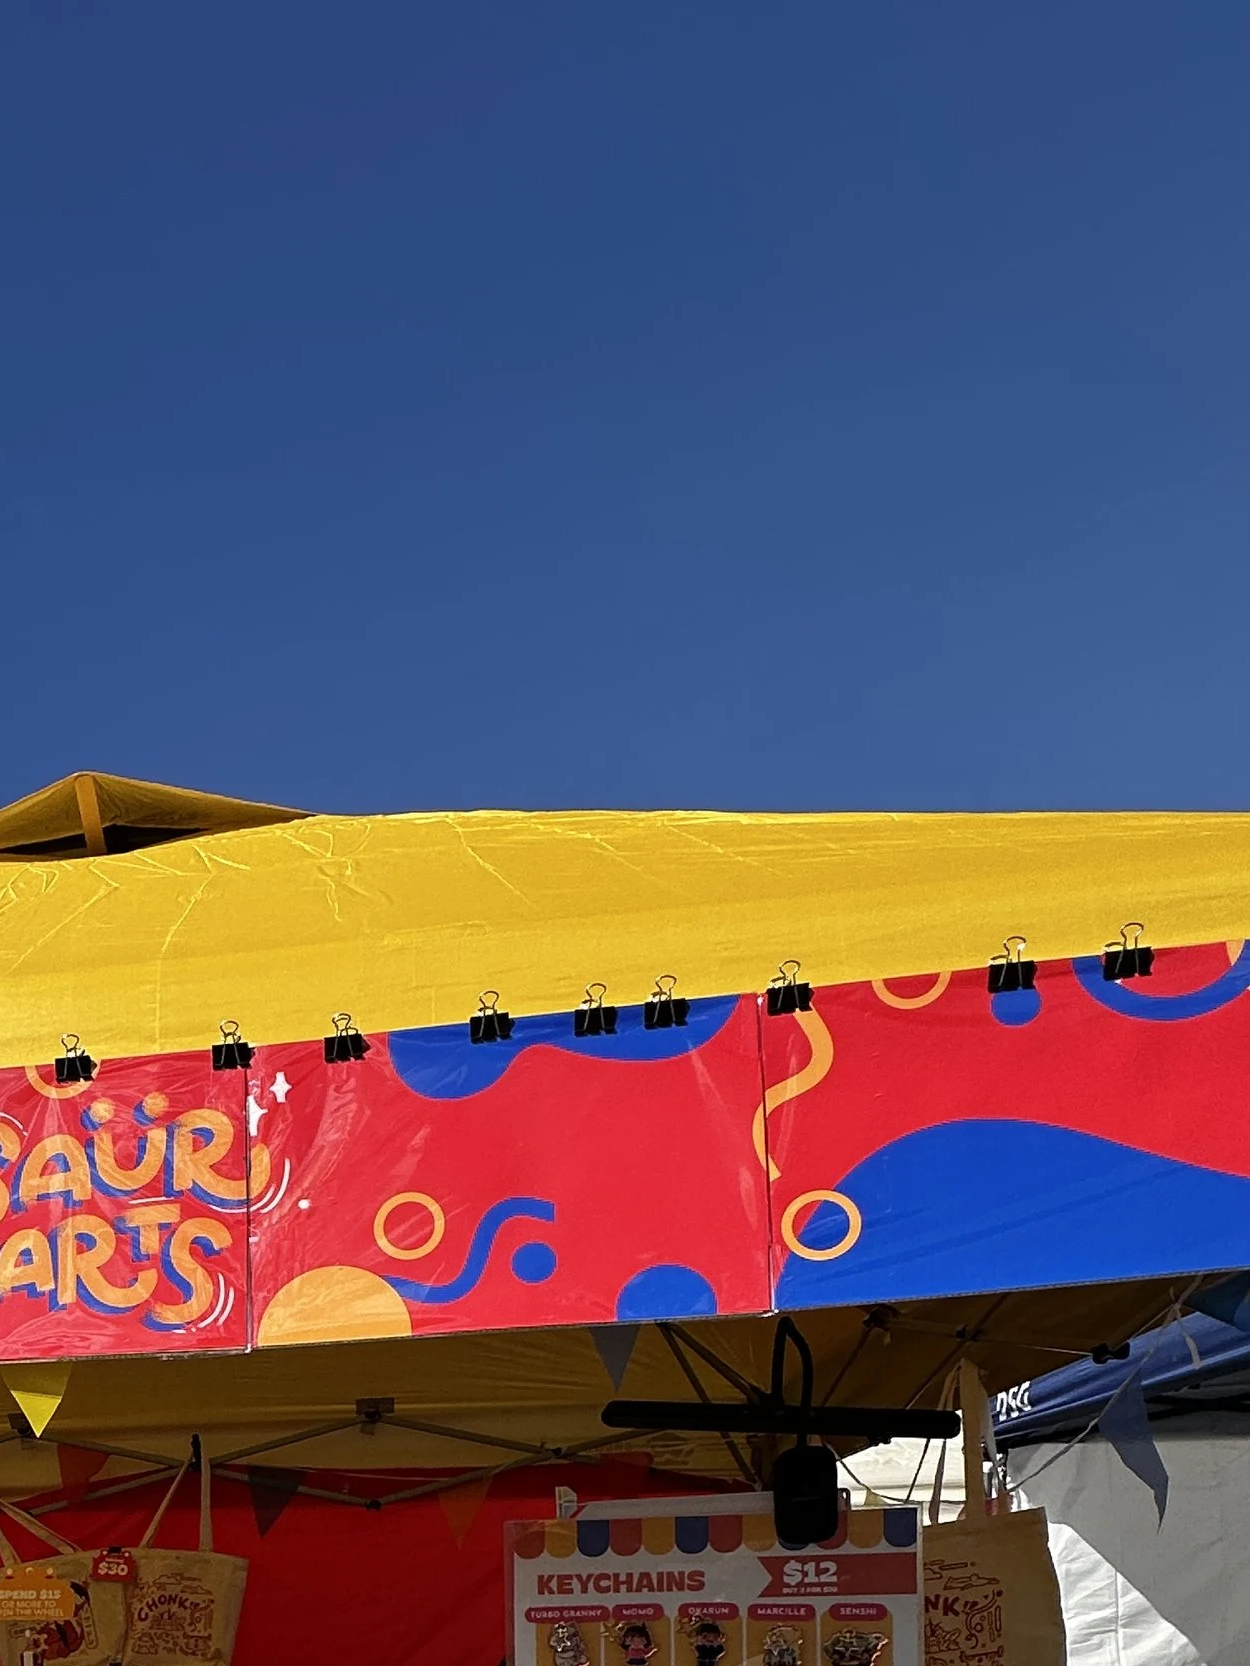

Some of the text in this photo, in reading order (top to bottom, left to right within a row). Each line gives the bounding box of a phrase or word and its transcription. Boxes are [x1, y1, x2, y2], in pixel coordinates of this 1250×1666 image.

[98, 1562, 128, 1577] $30
[782, 1560, 838, 1584] $12
[537, 1570, 705, 1596] KEYCHAINS
[757, 1607, 805, 1616] MARCILLE
[839, 1607, 876, 1616] SENSHI
